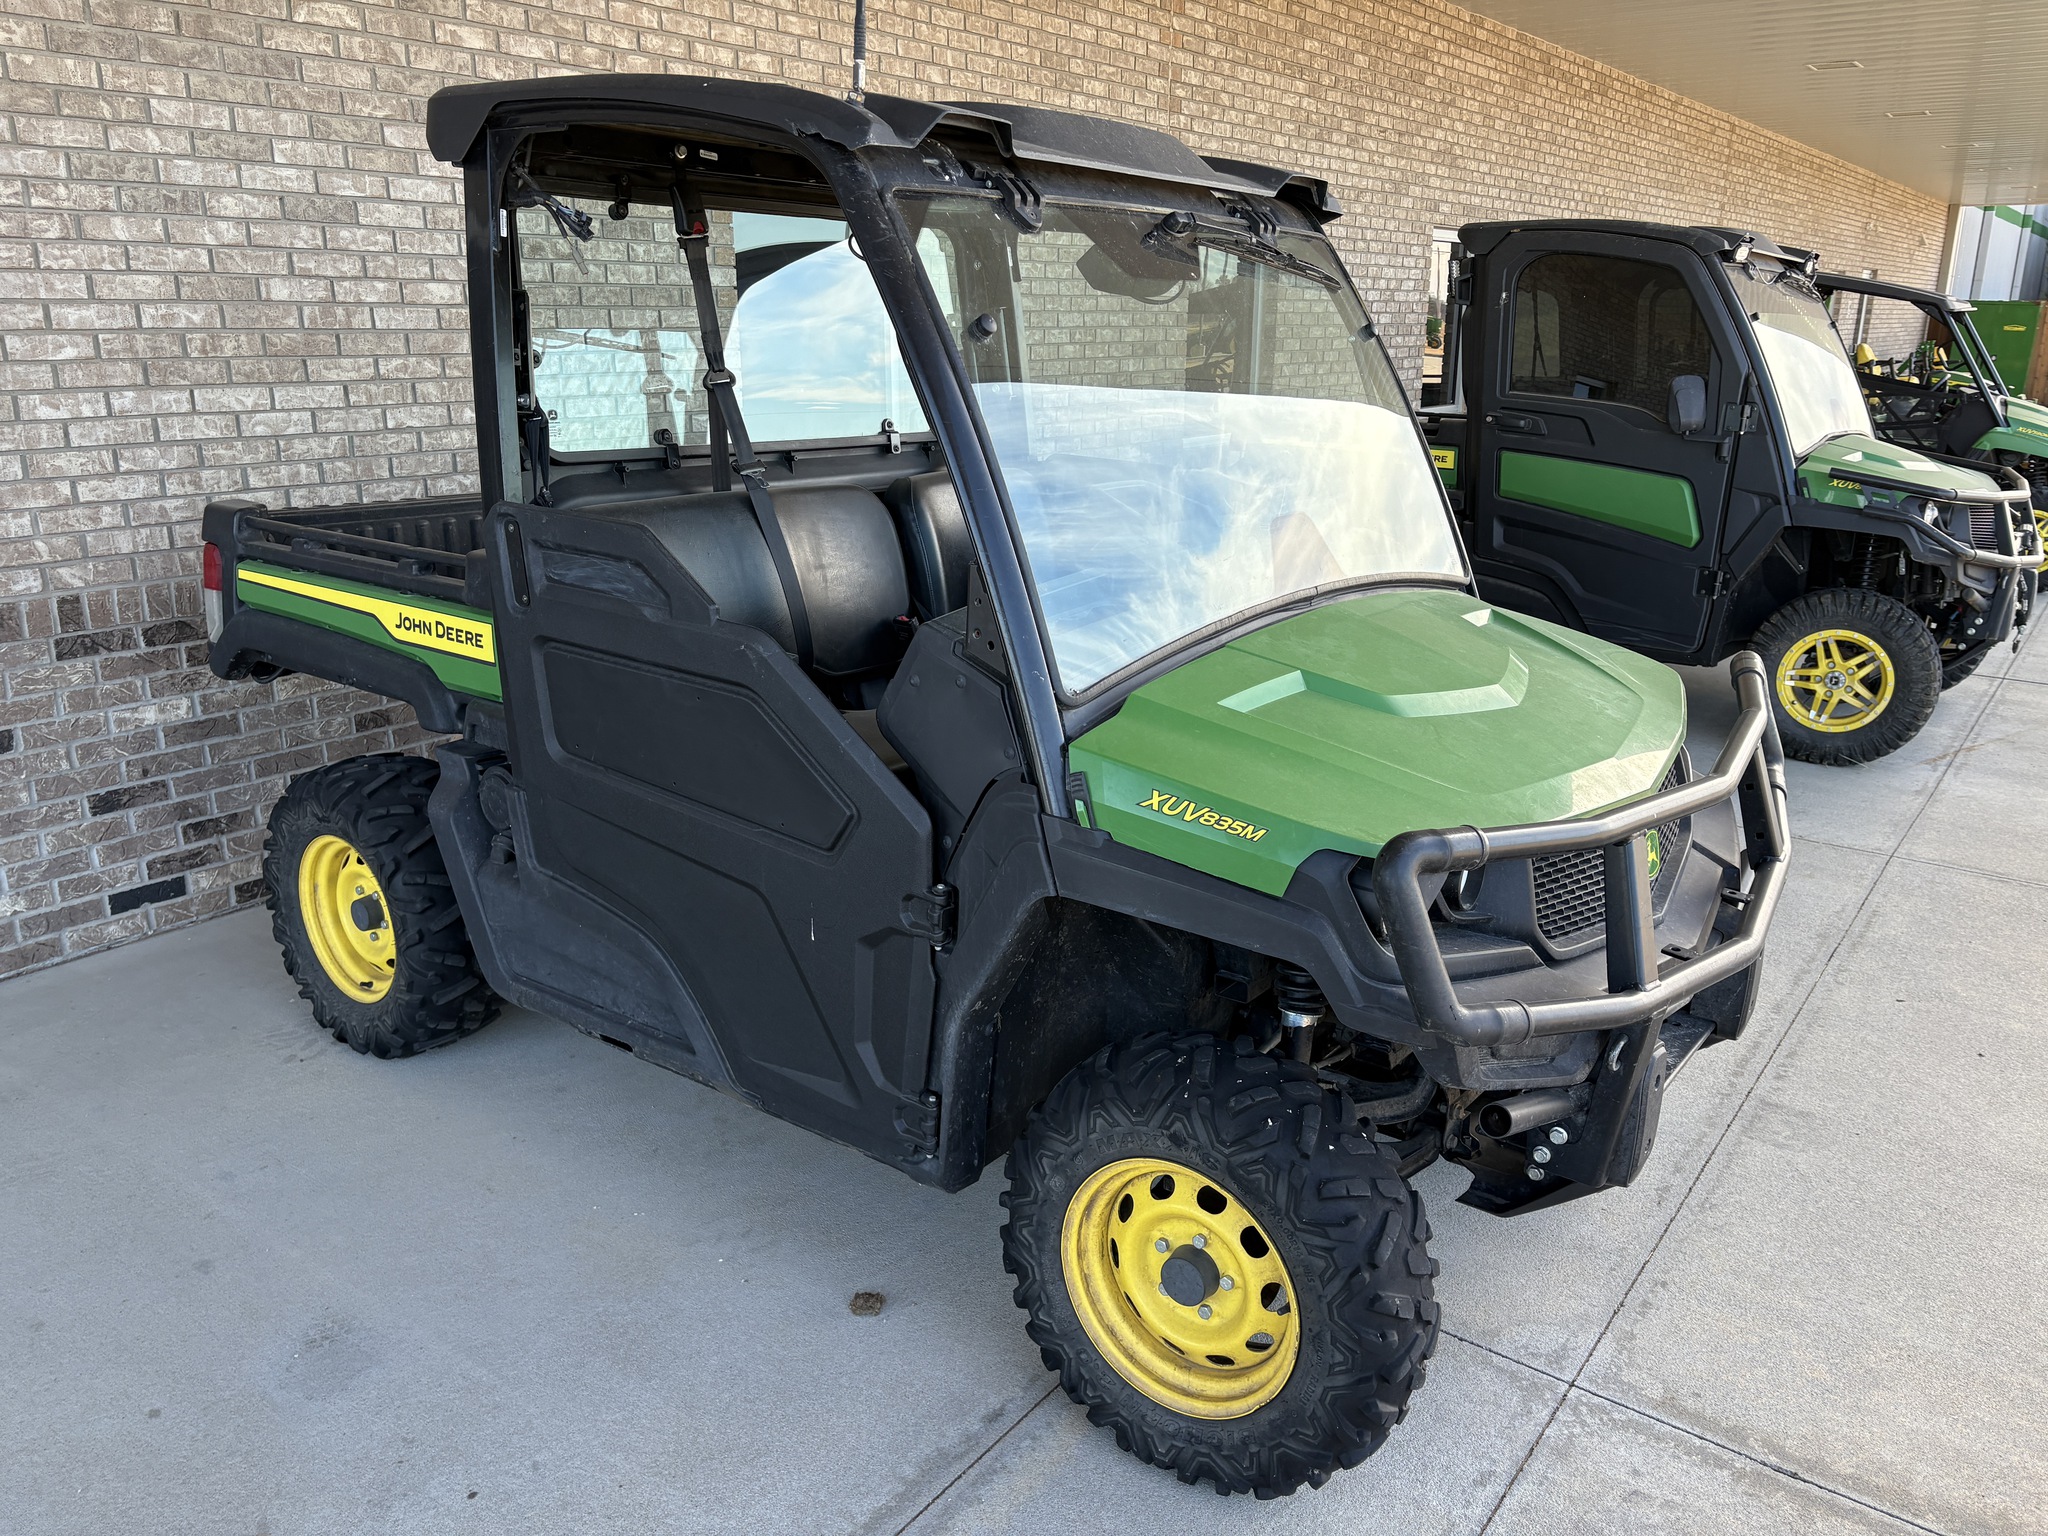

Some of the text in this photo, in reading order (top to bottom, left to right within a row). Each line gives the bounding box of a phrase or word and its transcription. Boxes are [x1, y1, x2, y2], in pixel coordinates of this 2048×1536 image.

[395, 612, 484, 649] JOHN DEERE
[1136, 788, 1270, 842] XUV835M
